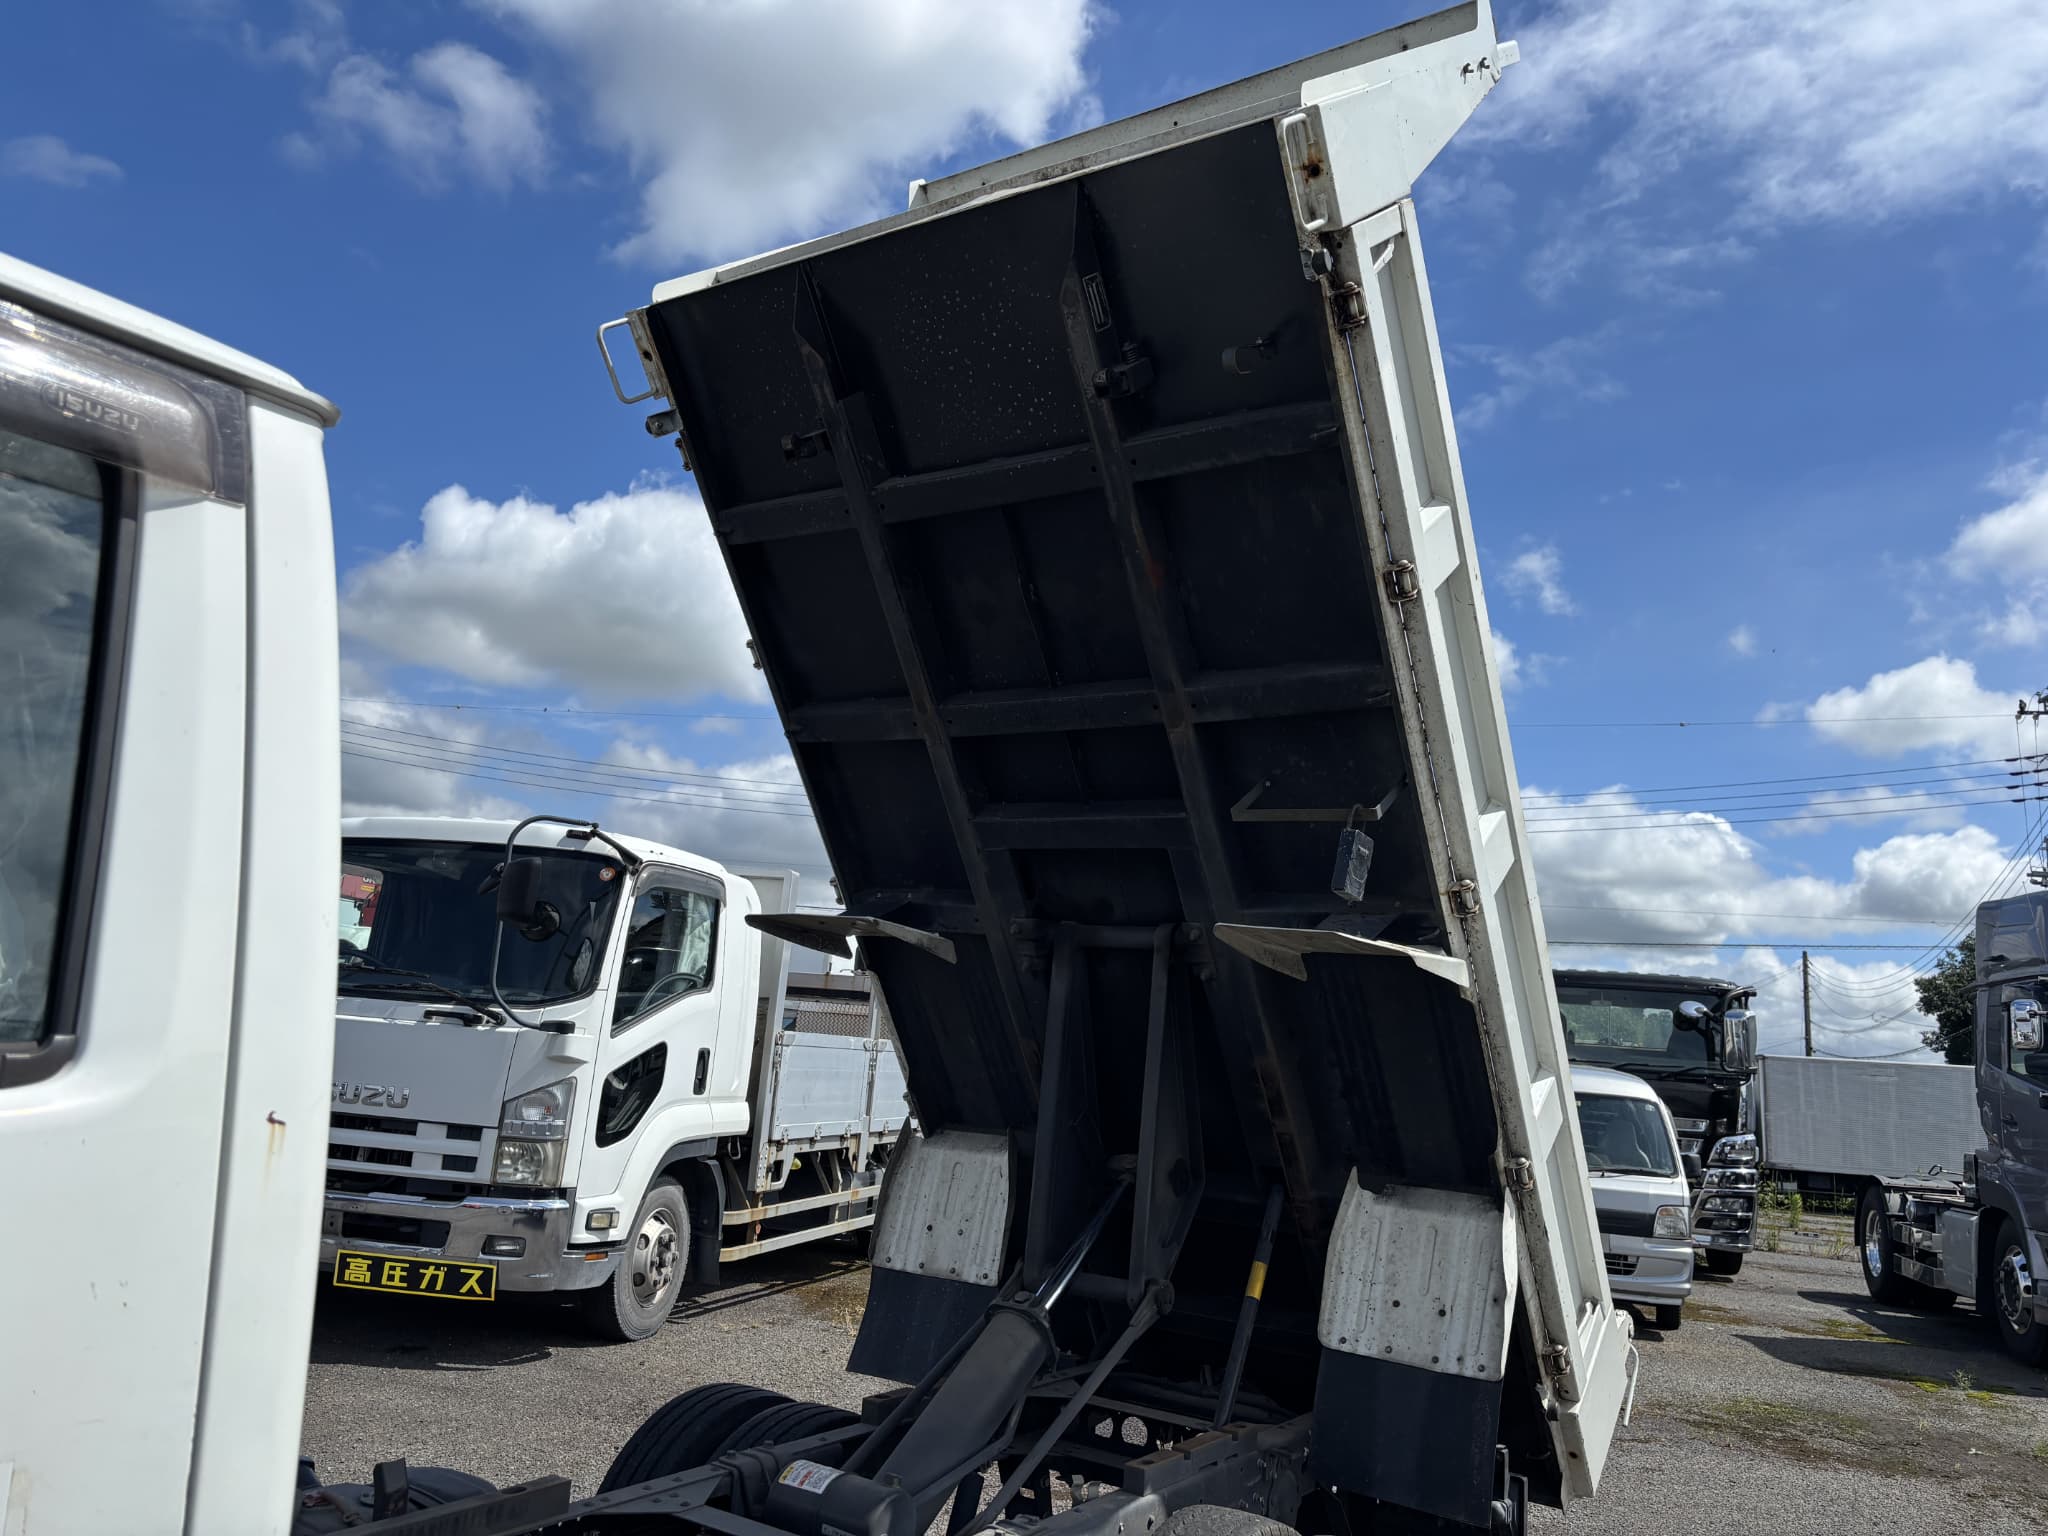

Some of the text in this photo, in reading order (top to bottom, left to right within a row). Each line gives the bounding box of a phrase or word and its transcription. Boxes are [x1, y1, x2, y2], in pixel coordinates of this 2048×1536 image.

[57, 390, 140, 431] ISUZU
[332, 1080, 410, 1109] UZU
[344, 1257, 484, 1295] 高圧ガス
